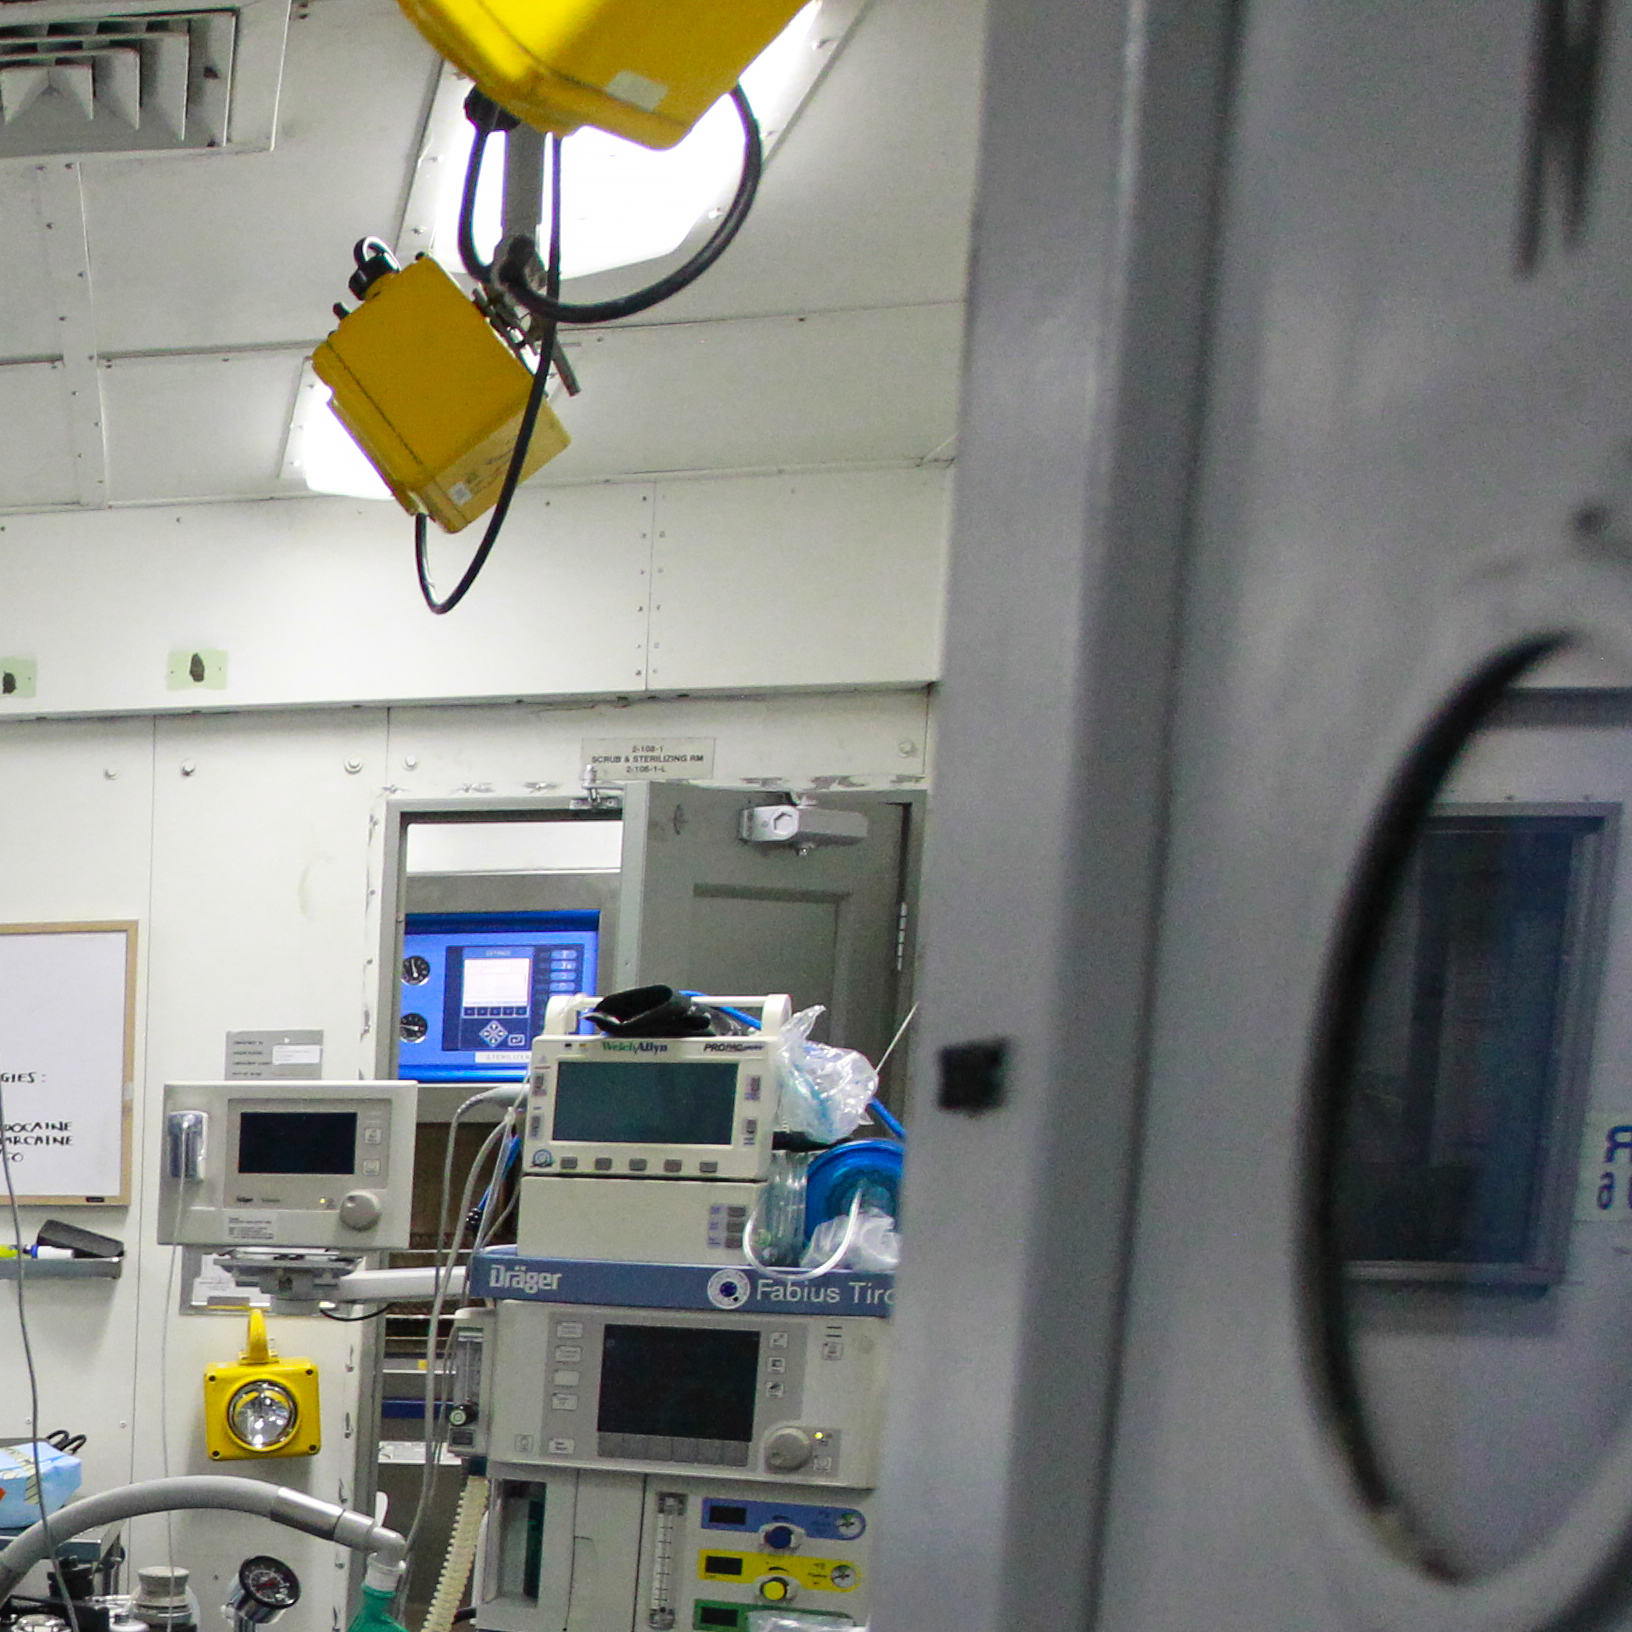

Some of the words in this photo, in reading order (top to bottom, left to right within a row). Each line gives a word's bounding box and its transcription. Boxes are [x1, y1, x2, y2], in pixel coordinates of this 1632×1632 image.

[633, 755, 687, 763] STERILIZING
[490, 1264, 562, 1294] Dräger
[756, 1278, 840, 1304] Fabius
